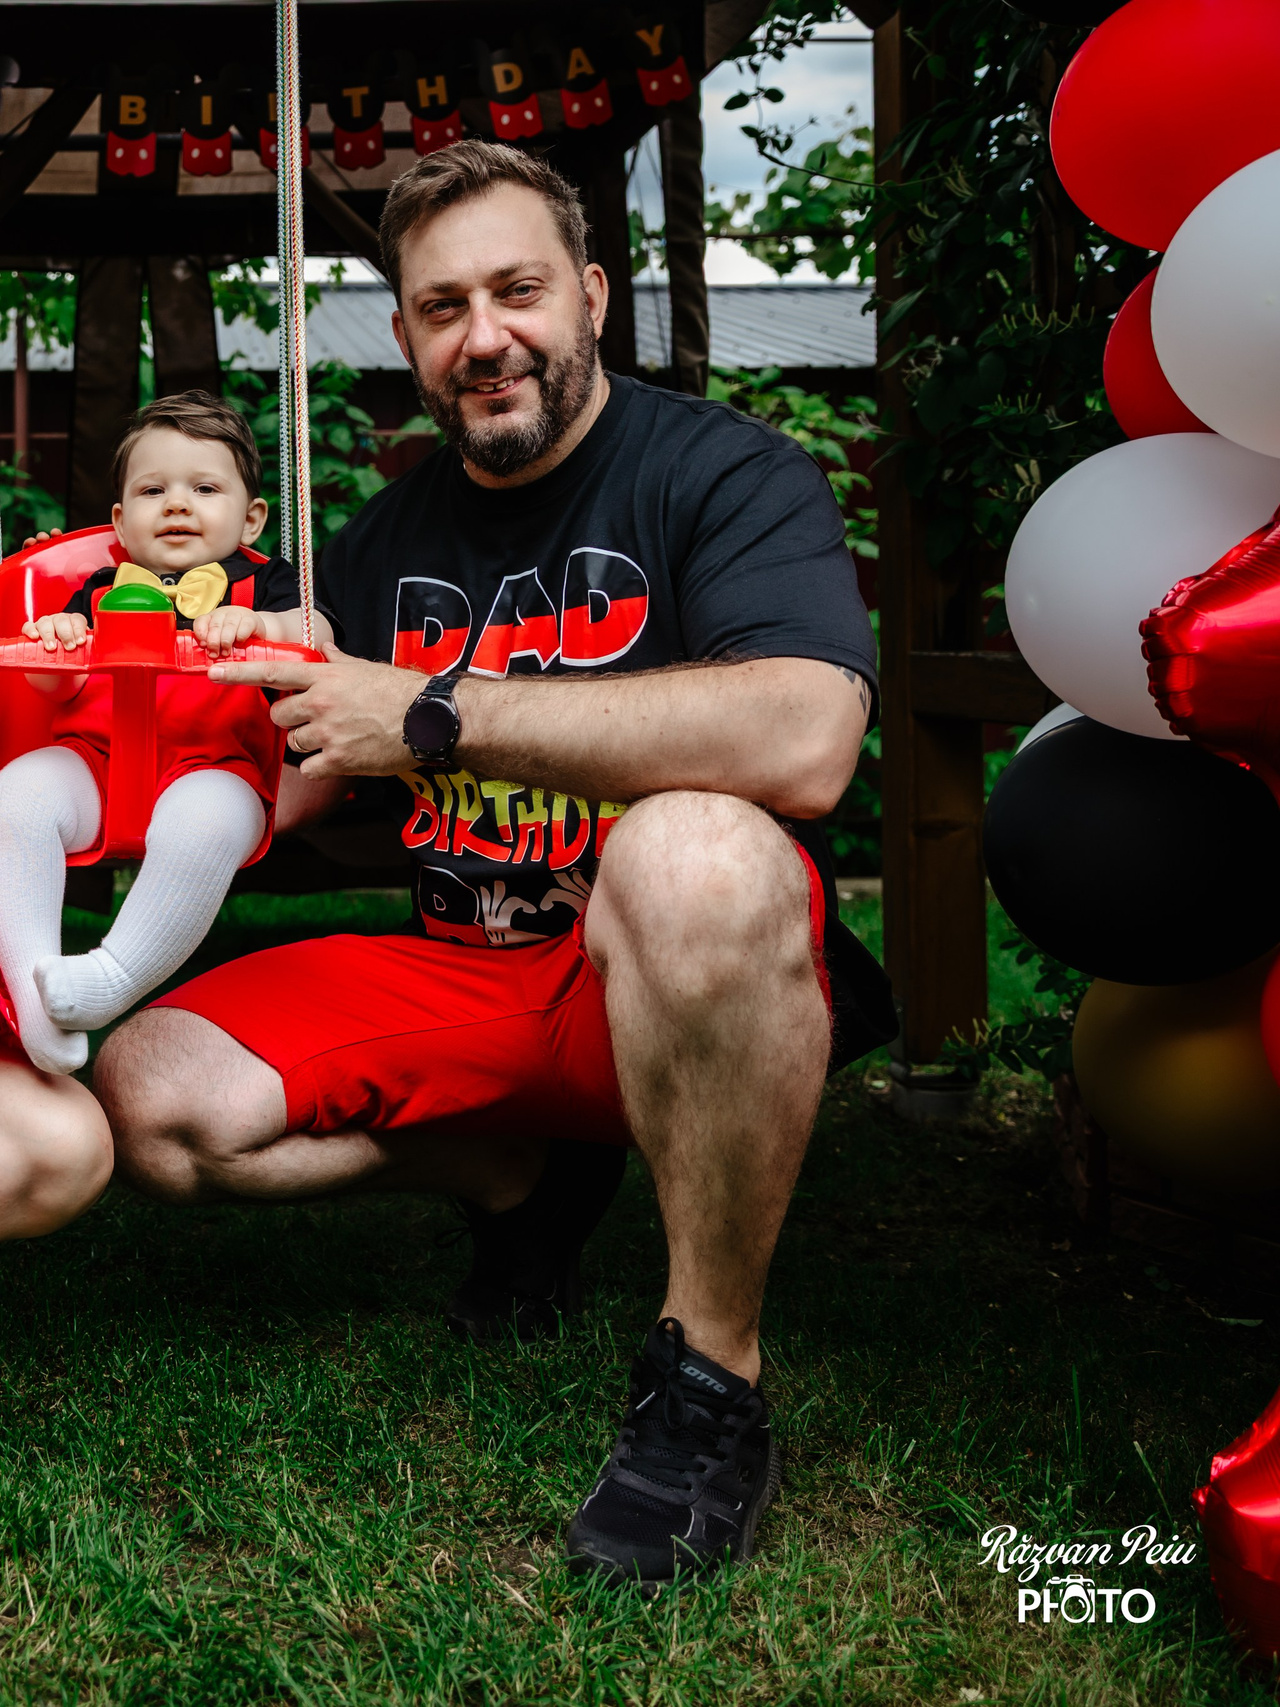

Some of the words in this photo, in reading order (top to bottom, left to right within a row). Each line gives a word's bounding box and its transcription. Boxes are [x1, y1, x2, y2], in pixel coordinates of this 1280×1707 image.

[119, 24, 665, 126] BITHDAY
[392, 546, 650, 679] DAD
[396, 768, 629, 871] BIRTHD
